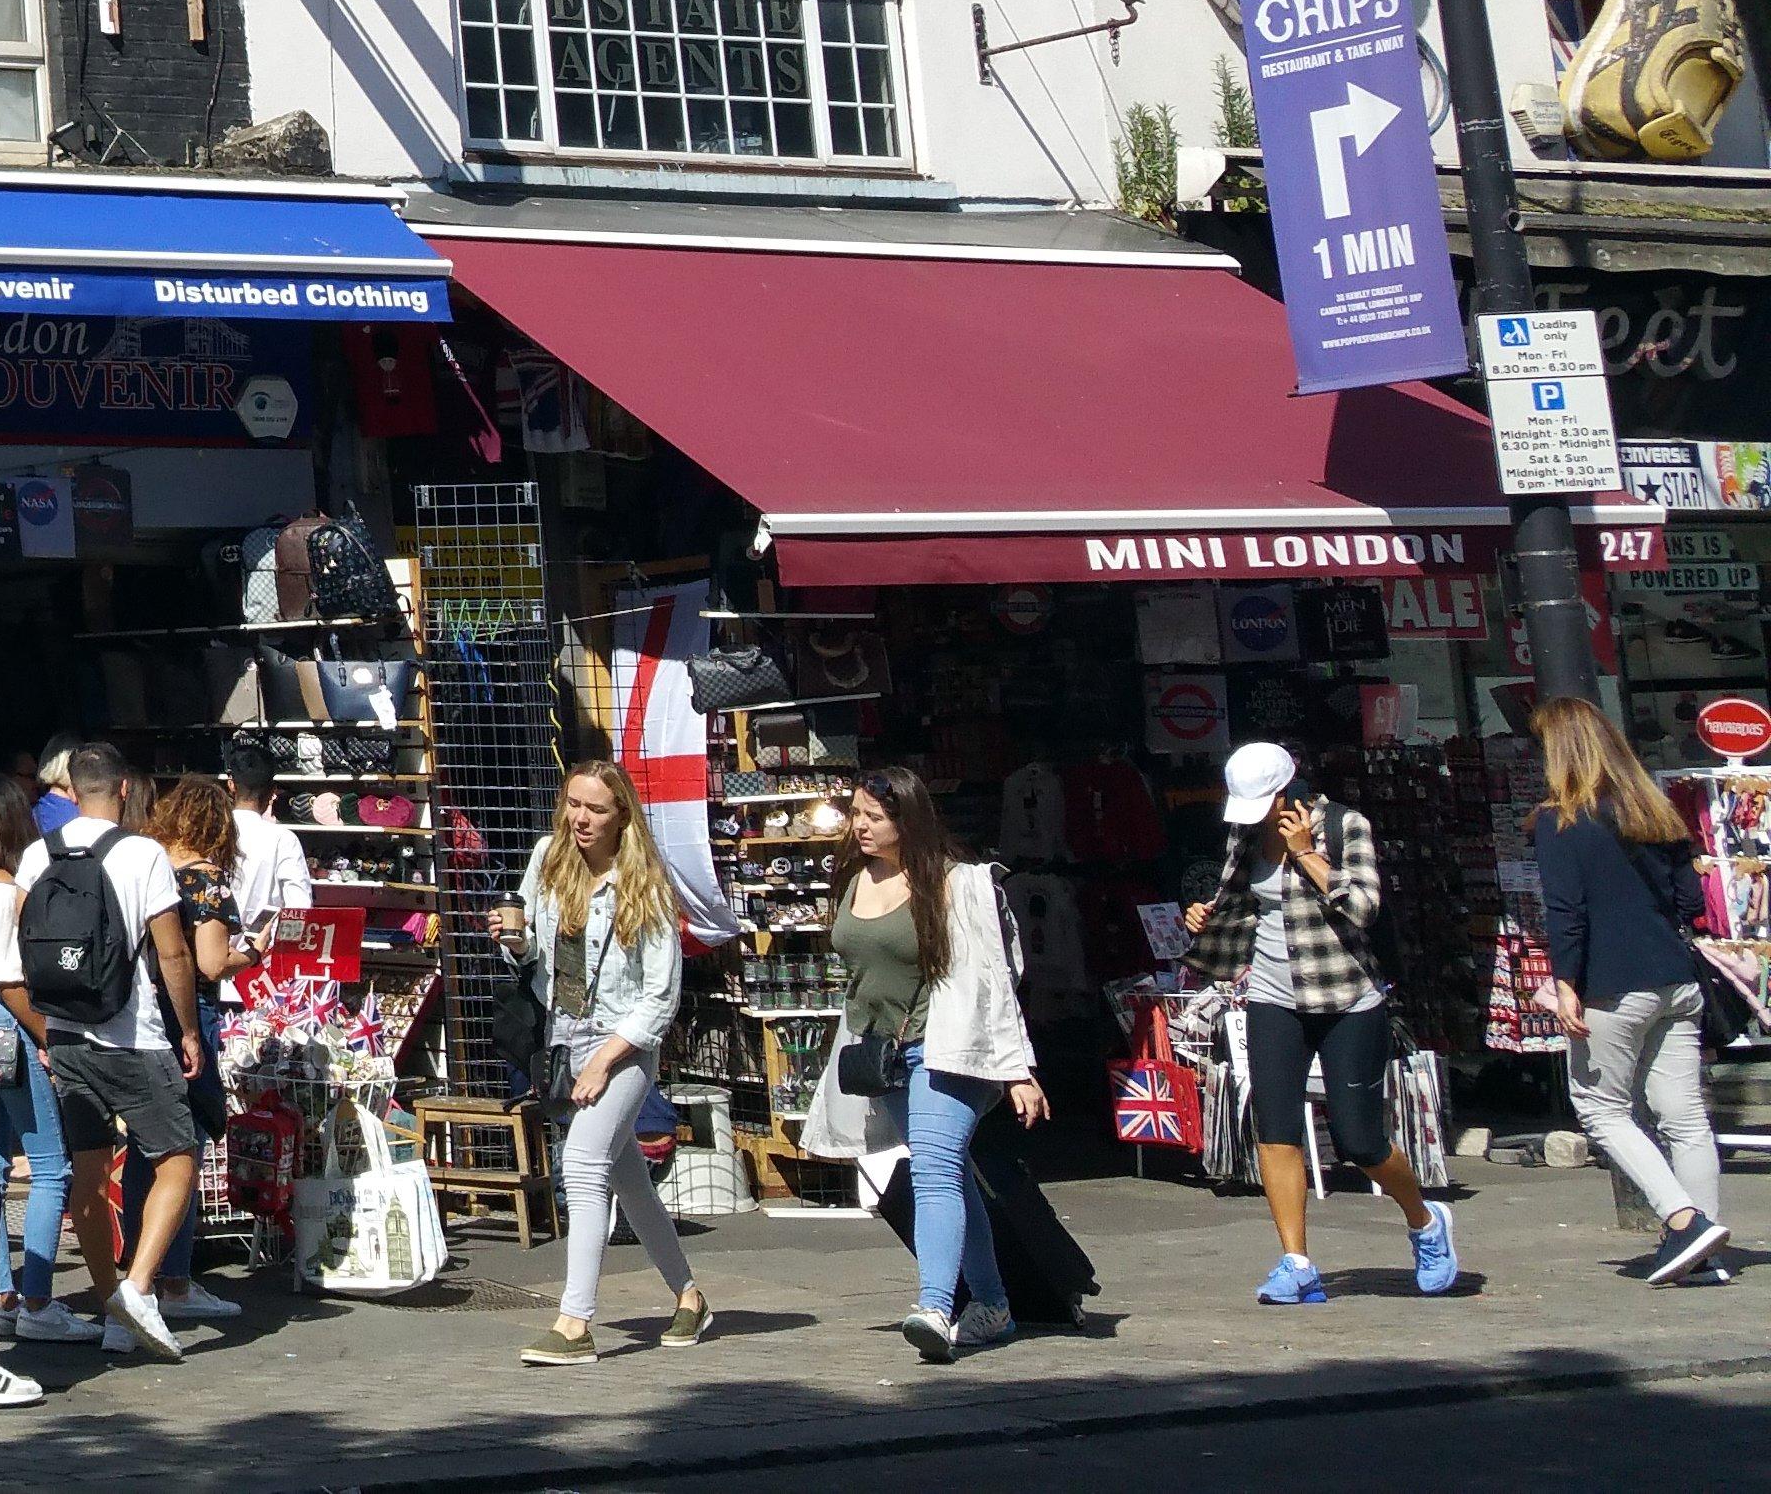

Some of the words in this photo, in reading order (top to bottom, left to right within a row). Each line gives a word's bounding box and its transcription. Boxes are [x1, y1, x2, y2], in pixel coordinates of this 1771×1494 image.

[1261, 54, 1332, 79] RESTAURANT
[1334, 49, 1344, 63] &
[1346, 41, 1373, 61] TAKE
[1375, 34, 1405, 54] AWAY
[557, 35, 805, 94] AGENTS
[1312, 237, 1334, 280] 1
[1342, 223, 1416, 276] MIN
[155, 279, 298, 307] Disturbed
[305, 283, 429, 313] Clothing
[1532, 320, 1578, 331] Loading
[1543, 332, 1568, 342] only
[1517, 351, 1543, 361] Mon
[1551, 350, 1568, 360] Fri
[1492, 365, 1520, 375] 8.30
[1522, 365, 1540, 373] am
[1578, 363, 1598, 373] pm
[1539, 384, 1560, 409] P
[1527, 416, 1553, 426] Mon
[1561, 415, 1578, 425] Fri
[1500, 430, 1553, 441] Midnight
[1560, 427, 1589, 438] 8.30
[1591, 428, 1609, 437] am
[1501, 441, 1530, 451] 6.30
[1532, 442, 1550, 452] pm
[1559, 438, 1611, 450] Midnight
[1529, 455, 1551, 464] Sat
[1552, 454, 1560, 463] &
[1564, 454, 1588, 463] Sun
[1506, 468, 1559, 479] Midnight
[1566, 465, 1595, 476] 9.30
[1597, 467, 1615, 475] am
[1517, 480, 1526, 489] 6
[1527, 481, 1546, 491] pm
[1555, 478, 1607, 489] Midnight
[1662, 471, 1703, 507] STAR
[21, 496, 56, 509] NASA
[1085, 535, 1227, 571] MINI
[1244, 532, 1465, 569] LONDON
[1599, 530, 1653, 562] 247
[1703, 536, 1722, 556] IS
[1630, 568, 1720, 589] POWERED
[1727, 567, 1751, 588] UP
[1381, 577, 1481, 629] ALE
[281, 909, 308, 920] SALE
[298, 922, 336, 964] £1
